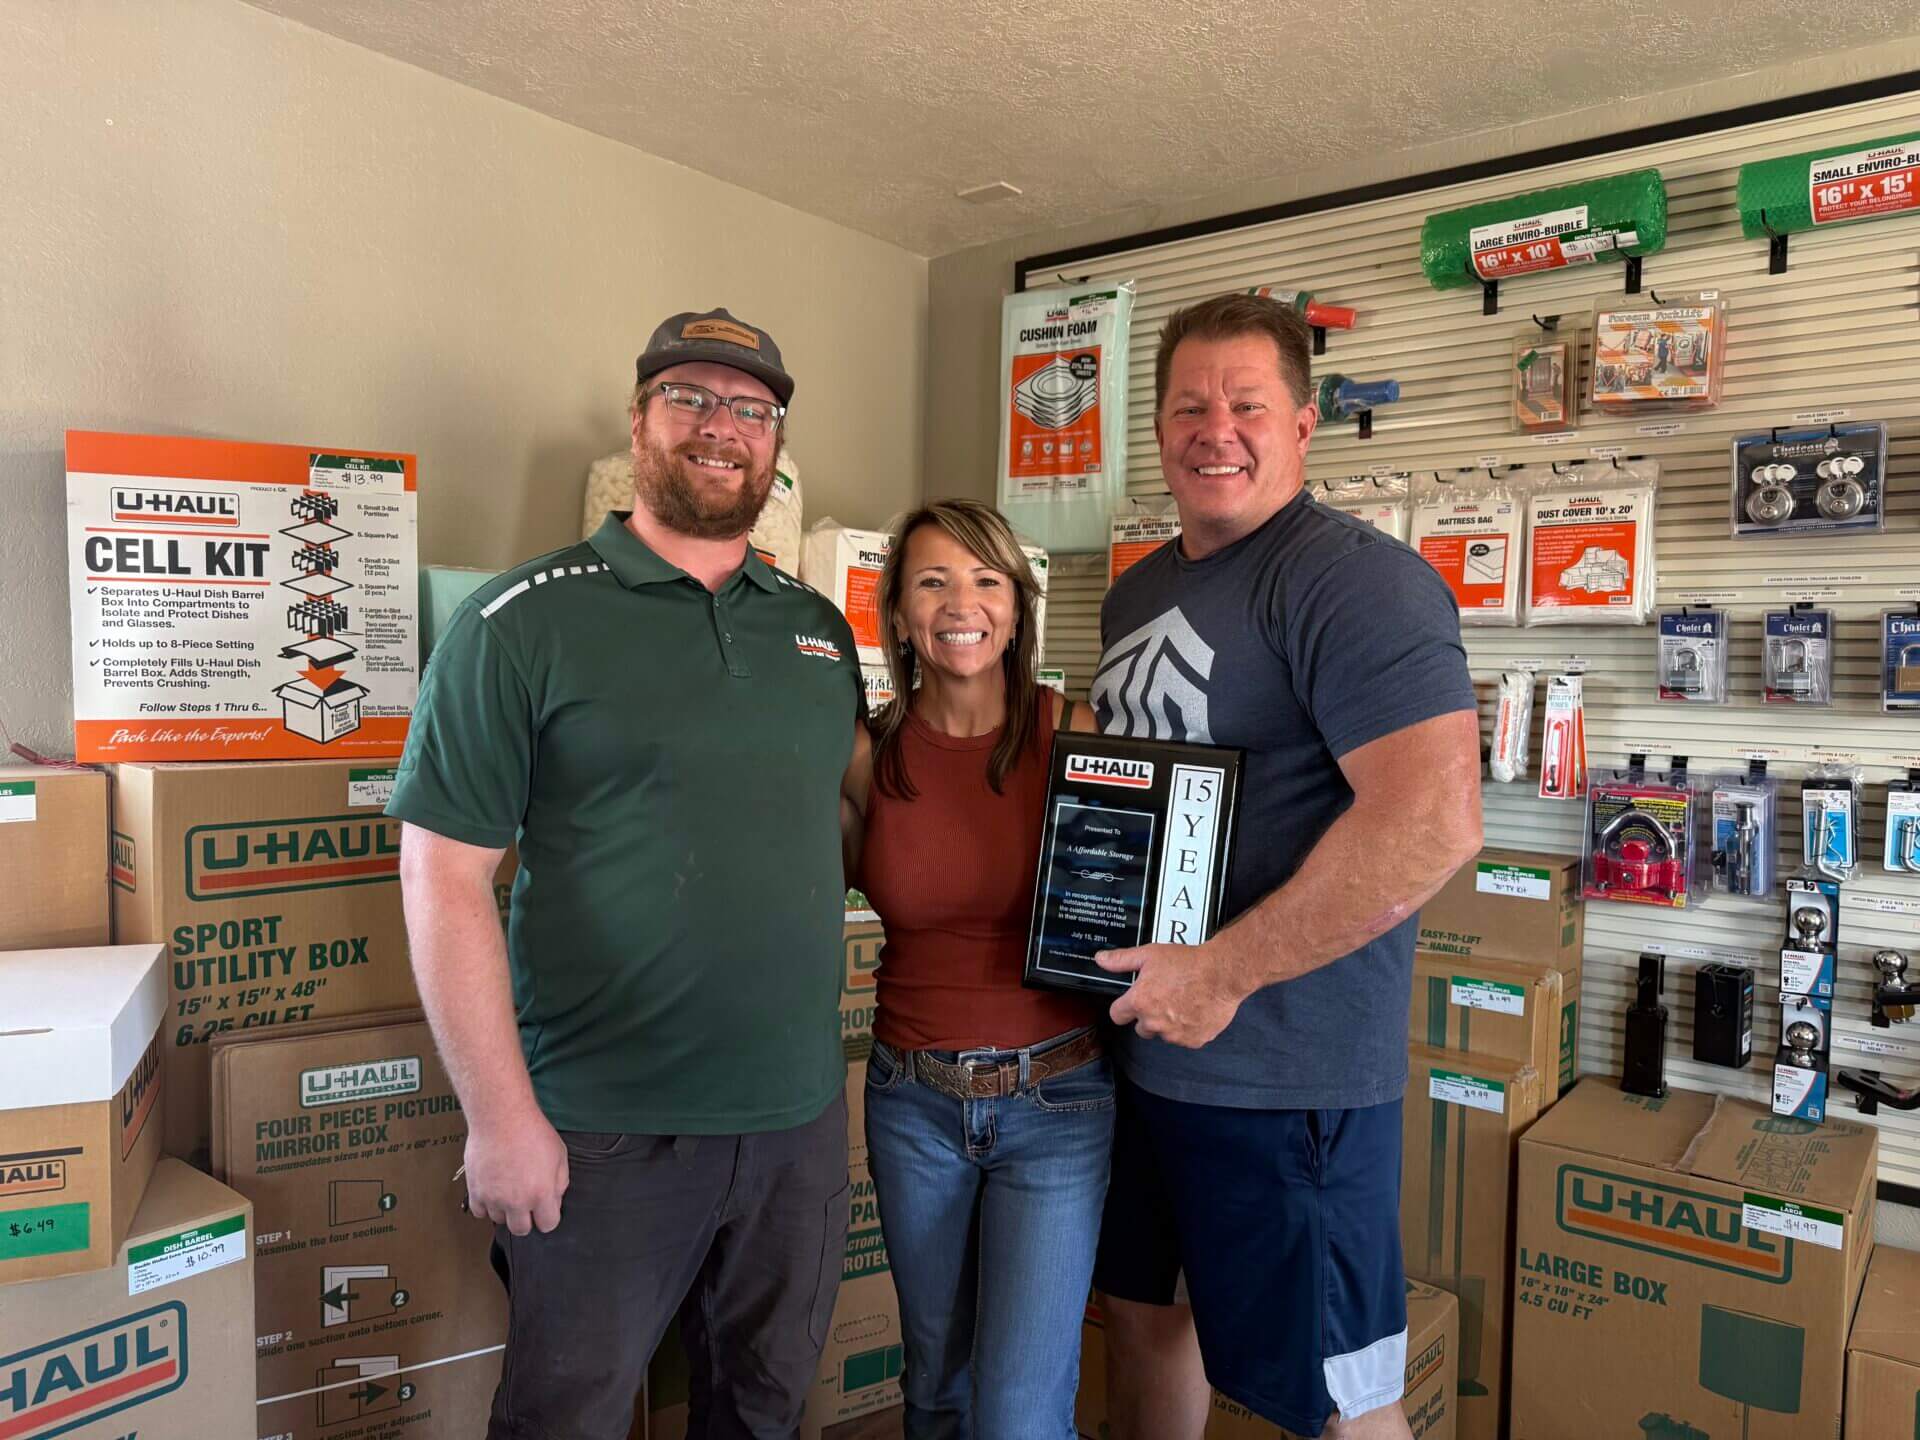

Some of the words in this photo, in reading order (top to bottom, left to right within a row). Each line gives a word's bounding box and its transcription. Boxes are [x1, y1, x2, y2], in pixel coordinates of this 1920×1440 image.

[1813, 166, 1853, 182] SMALL
[1857, 152, 1920, 174] ENVIRO-B
[1817, 183, 1855, 206] 16"
[1880, 172, 1912, 195] 15'
[1819, 202, 1848, 213] PROTECT
[1849, 199, 1867, 207] YOUR
[1474, 236, 1505, 250] LARGE
[1506, 220, 1584, 243] ENVIRO-BUBBLE
[1479, 253, 1507, 269] 16"
[1526, 243, 1551, 260] 10'
[1067, 319, 1097, 337] FOAM
[341, 472, 384, 485] $13.99
[117, 491, 235, 515] U-HAUL
[1537, 509, 1560, 519] DUST
[1562, 507, 1591, 518] COVER
[1596, 507, 1608, 515] 10'
[1618, 505, 1633, 514] 20'
[1437, 516, 1476, 526] MATTRESS
[1478, 515, 1493, 523] BAG
[85, 536, 191, 575] CELL
[205, 541, 270, 577] KIT
[859, 550, 886, 564] PICTU
[101, 587, 159, 598] Separates
[163, 588, 200, 598] U-Haul
[204, 589, 229, 599] Dish
[232, 590, 264, 600] Barrel
[101, 598, 123, 606] Box
[127, 598, 149, 607] Into
[153, 599, 235, 610] Compartments
[239, 600, 249, 609] to
[101, 608, 140, 617] Isolate
[144, 609, 164, 618] and
[168, 610, 208, 619] Protect
[212, 610, 249, 619] Dishes
[102, 619, 123, 628] and
[127, 619, 175, 628] Glasses.
[102, 639, 135, 648] Holds
[139, 641, 153, 650] up
[157, 640, 167, 648] to
[171, 639, 213, 648] 8-Piece
[216, 640, 254, 650] Setting
[795, 634, 839, 652] U-HAUL
[103, 657, 167, 669] Completely
[171, 658, 192, 667] Fills
[196, 658, 233, 667] U-Haul
[237, 659, 261, 668] Dish
[103, 668, 138, 677] Barrel
[141, 668, 166, 677] Box.
[169, 669, 197, 678] Adds
[201, 669, 251, 679] Strength,
[104, 679, 153, 688] Prevents
[157, 679, 210, 689] Crushing.
[139, 703, 176, 712] Follow
[179, 703, 211, 713] Steps
[214, 703, 220, 712] 1
[224, 702, 249, 712] Thru
[109, 728, 149, 744] Pack
[150, 727, 182, 742] Like
[184, 728, 209, 742] the
[210, 726, 273, 746] Experts!
[1070, 757, 1149, 779] U-HAUL
[1183, 777, 1213, 803] 15
[1085, 825, 1113, 834] Presented
[202, 824, 401, 869] U-HAUL
[1073, 846, 1108, 857] Affordable
[1109, 850, 1135, 861] Storage
[1169, 814, 1205, 945] YEAR
[1063, 899, 1096, 910] outstanding
[1097, 903, 1117, 912] service
[1072, 892, 1103, 901] recognition
[1064, 913, 1078, 921] their
[1078, 915, 1110, 927] community
[1110, 921, 1126, 929] since
[1069, 906, 1098, 917] customers
[1107, 911, 1127, 921] U-Haul
[173, 915, 283, 956] SPORT
[1071, 931, 1083, 940] July
[1084, 933, 1093, 941] 15,
[1094, 934, 1108, 943] 2011
[1420, 929, 1482, 945] EASY-TO-LIFT
[1429, 941, 1472, 955] HANDLES
[174, 946, 296, 991] UTILITY
[309, 937, 369, 971] BOX
[176, 996, 212, 1017] 15"
[218, 996, 229, 1009] x
[236, 988, 270, 1008] 15"
[275, 987, 287, 1000] x
[289, 978, 328, 998] 48"
[308, 1062, 415, 1092] U-HAUL
[256, 1115, 312, 1140] FOUR
[320, 1106, 377, 1131] PIECE
[256, 1132, 340, 1162] MIRROR
[348, 1124, 388, 1148] BOX
[256, 1155, 332, 1175] Accommodates
[334, 1151, 358, 1162] sizes
[360, 1151, 373, 1160] up
[375, 1147, 385, 1156] to
[387, 1143, 404, 1154] 40"
[383, 1195, 391, 1209] 1
[1780, 1206, 1803, 1215] LARGE
[1572, 1178, 1776, 1253] U-HAUL
[9, 1219, 55, 1237] $6.49
[1784, 1218, 1818, 1236] $4.99
[163, 1243, 183, 1253] DISH
[184, 1232, 214, 1246] BARREL
[256, 1232, 283, 1245] STEP
[286, 1230, 291, 1240] 1
[256, 1241, 306, 1257] Assemble
[310, 1237, 326, 1248] the
[329, 1233, 349, 1244] four
[352, 1225, 397, 1239] sections.
[184, 1243, 225, 1268] $10.99
[1520, 1248, 1604, 1290] LARGE
[1613, 1272, 1669, 1306] BOX
[1521, 1276, 1541, 1288] 18"
[1542, 1282, 1550, 1291] x
[1554, 1283, 1575, 1297] 18"
[1577, 1291, 1585, 1300] x
[395, 1291, 404, 1305] 2
[1519, 1291, 1544, 1309] 4.5
[1547, 1298, 1569, 1316] CU
[1572, 1305, 1593, 1321] FT
[256, 1345, 284, 1359] Slide
[286, 1342, 305, 1352] one
[309, 1333, 345, 1347] section
[348, 1327, 370, 1338] onto
[373, 1318, 407, 1333] bottom
[410, 1311, 443, 1325] corner.
[256, 1334, 281, 1347] STEP
[285, 1331, 292, 1341] 2
[0, 1324, 169, 1413] HAUL
[402, 1386, 411, 1398] 3
[366, 1422, 388, 1433] over
[390, 1409, 431, 1427] adjacent
